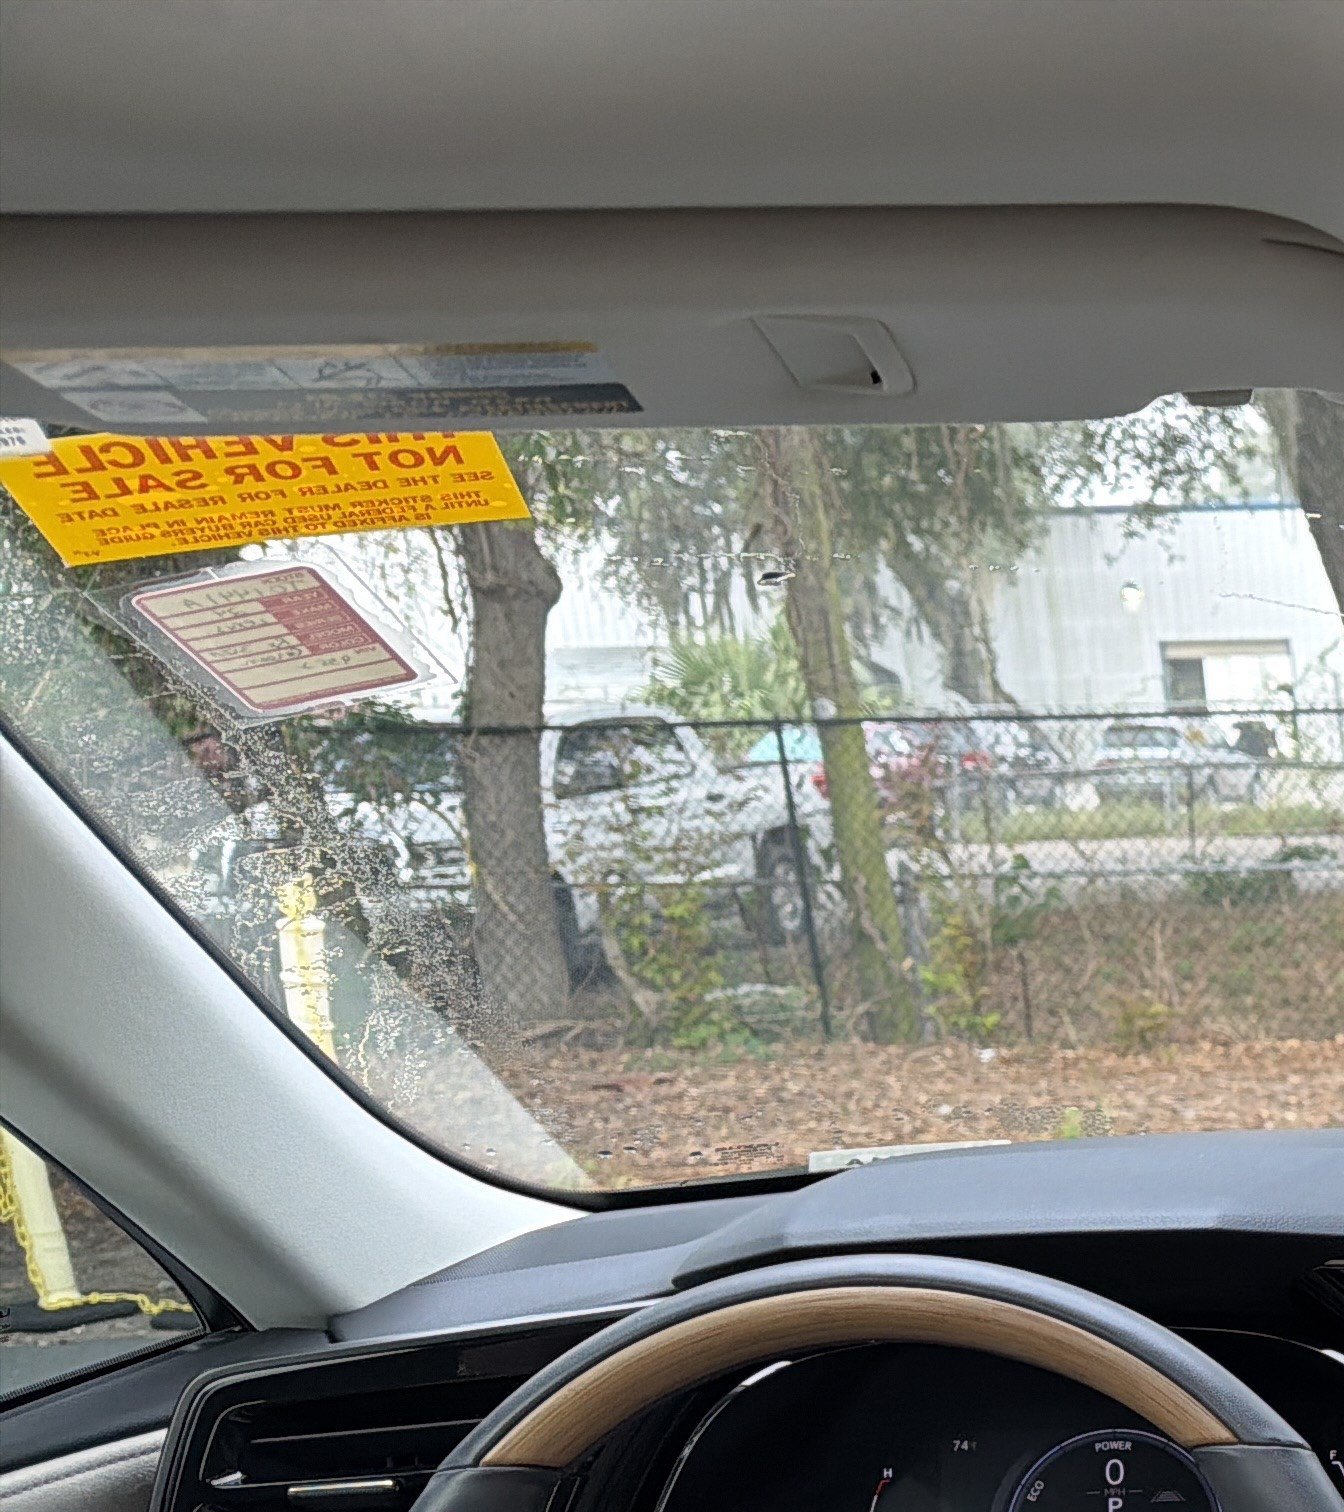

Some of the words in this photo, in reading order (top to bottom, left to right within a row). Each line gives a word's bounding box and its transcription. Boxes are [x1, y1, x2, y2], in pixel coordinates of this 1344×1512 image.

[1095, 1440, 1132, 1452] POWER
[1330, 1450, 1338, 1460] F
[883, 1467, 893, 1478] H
[1026, 1480, 1045, 1502] ECO
[1104, 1487, 1126, 1497] MPH
